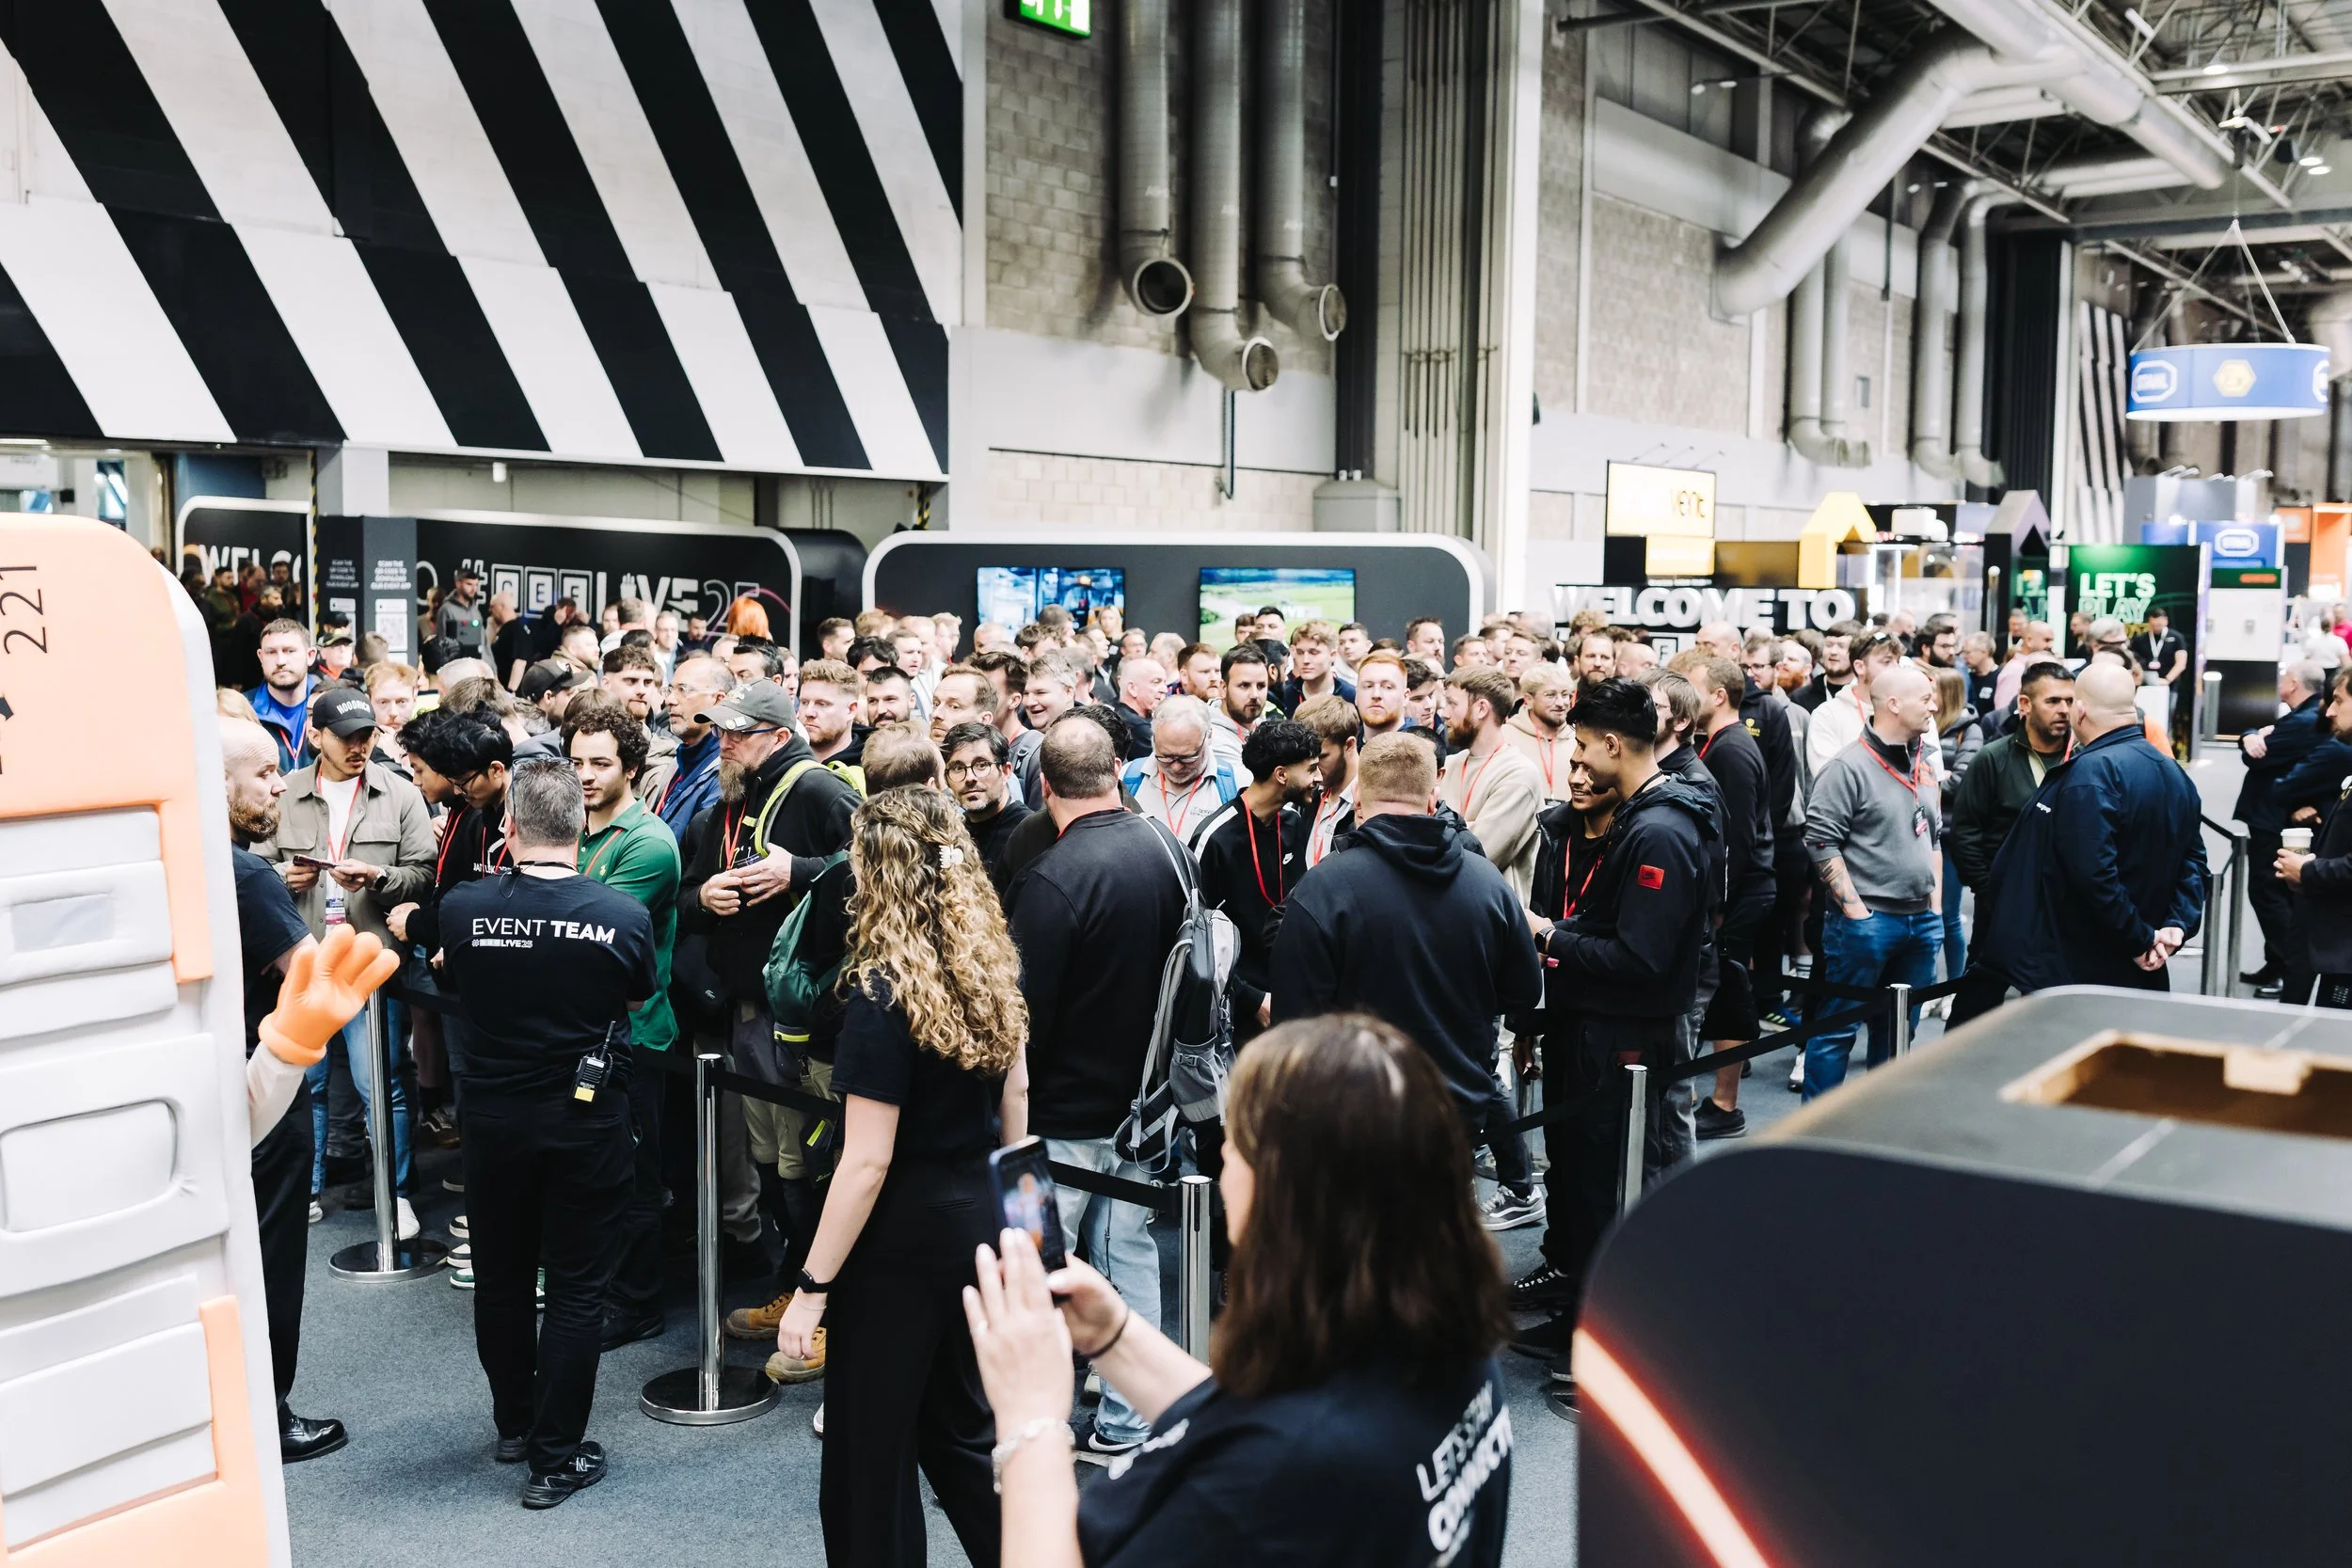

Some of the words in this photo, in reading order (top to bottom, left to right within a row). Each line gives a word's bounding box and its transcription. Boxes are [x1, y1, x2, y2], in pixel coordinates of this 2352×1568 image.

[2079, 572, 2156, 599] LET'S
[1551, 585, 1774, 630] WELCOME
[1778, 589, 1856, 631] TO
[472, 917, 547, 937] EVENT
[550, 920, 616, 944] TEAM
